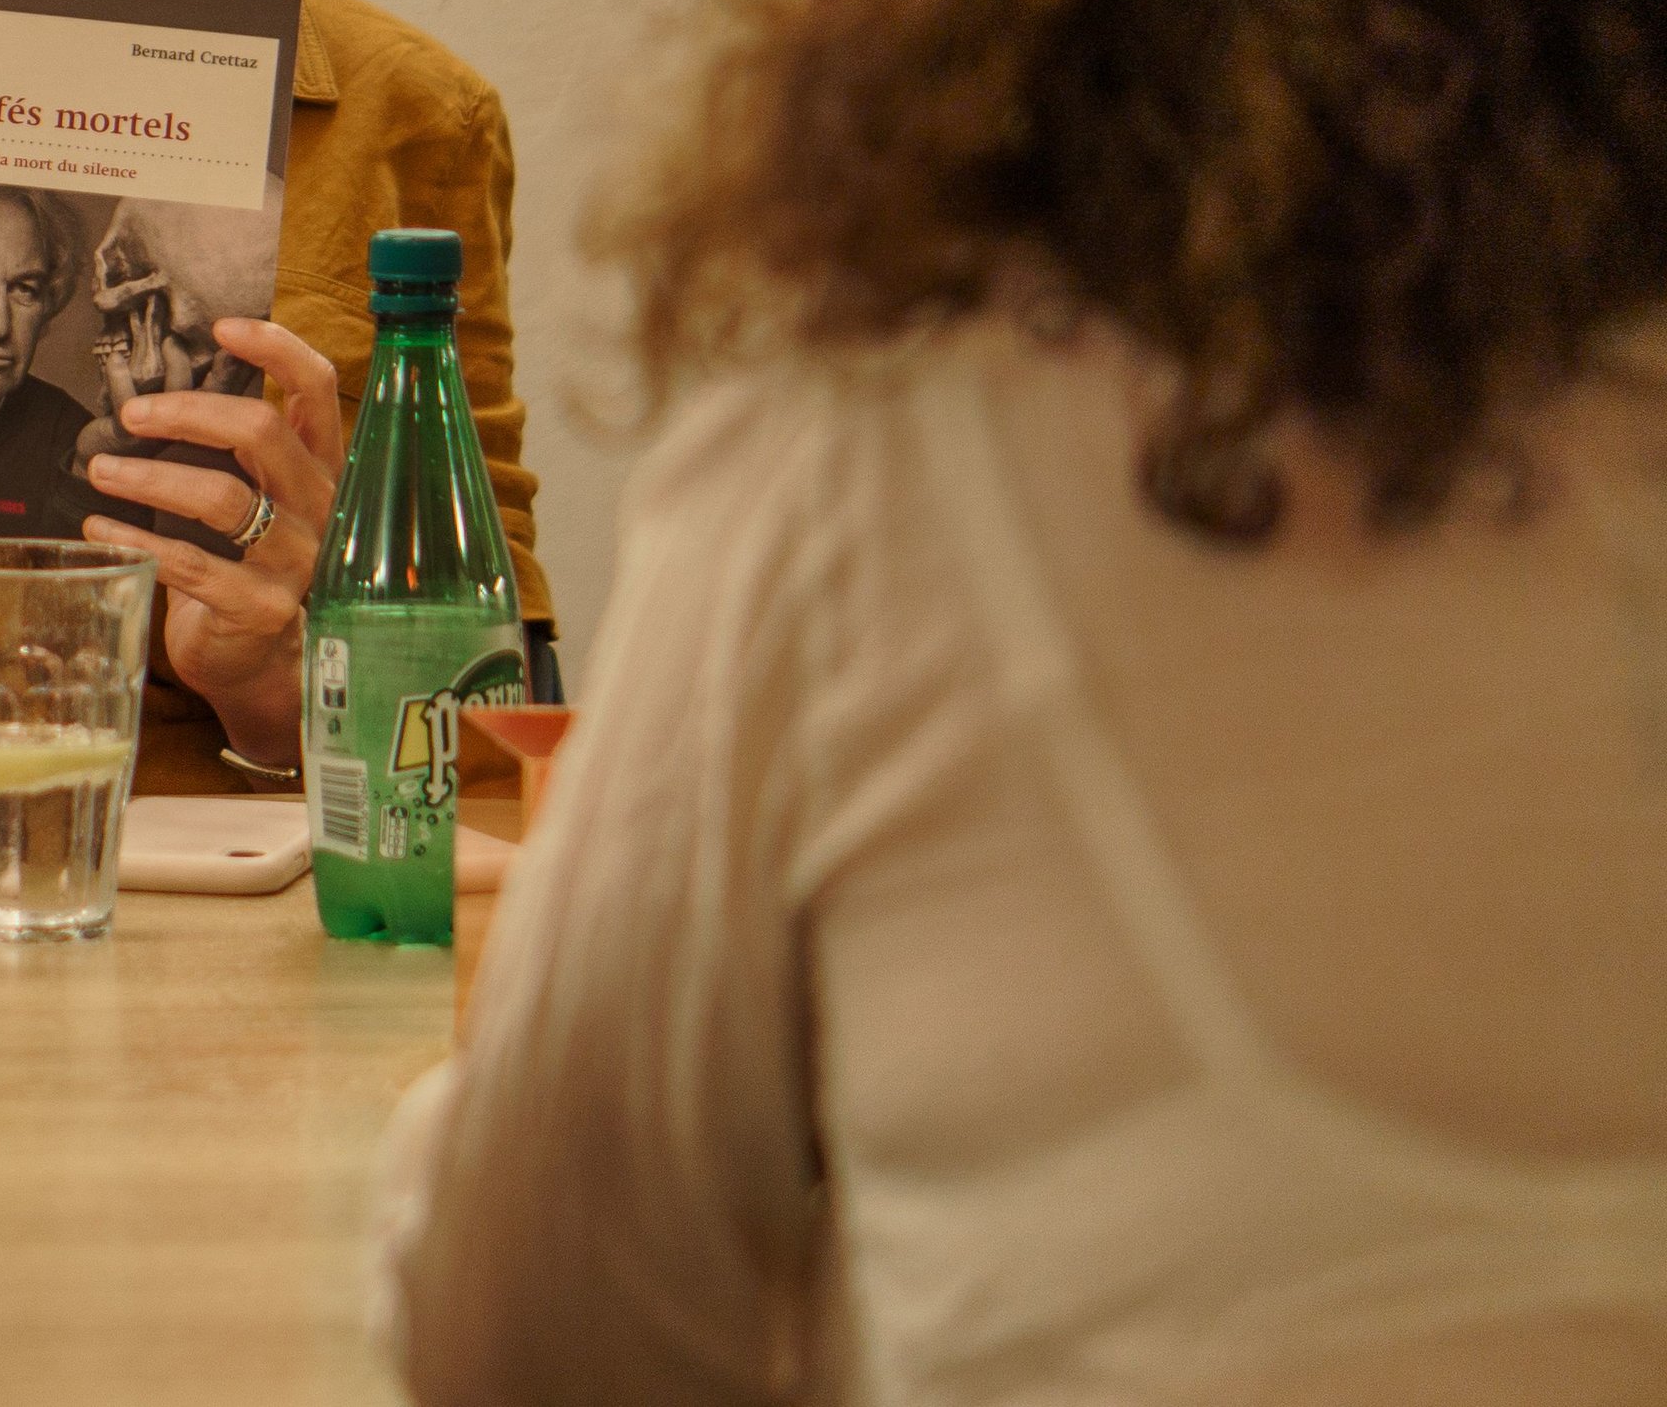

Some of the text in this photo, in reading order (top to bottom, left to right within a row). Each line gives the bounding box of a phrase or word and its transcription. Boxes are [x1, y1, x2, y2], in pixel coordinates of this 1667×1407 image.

[131, 43, 259, 69] Bernard Crettaz
[55, 107, 191, 142] mortels
[13, 155, 53, 171] mort
[57, 158, 78, 174] du
[82, 161, 138, 179] silence
